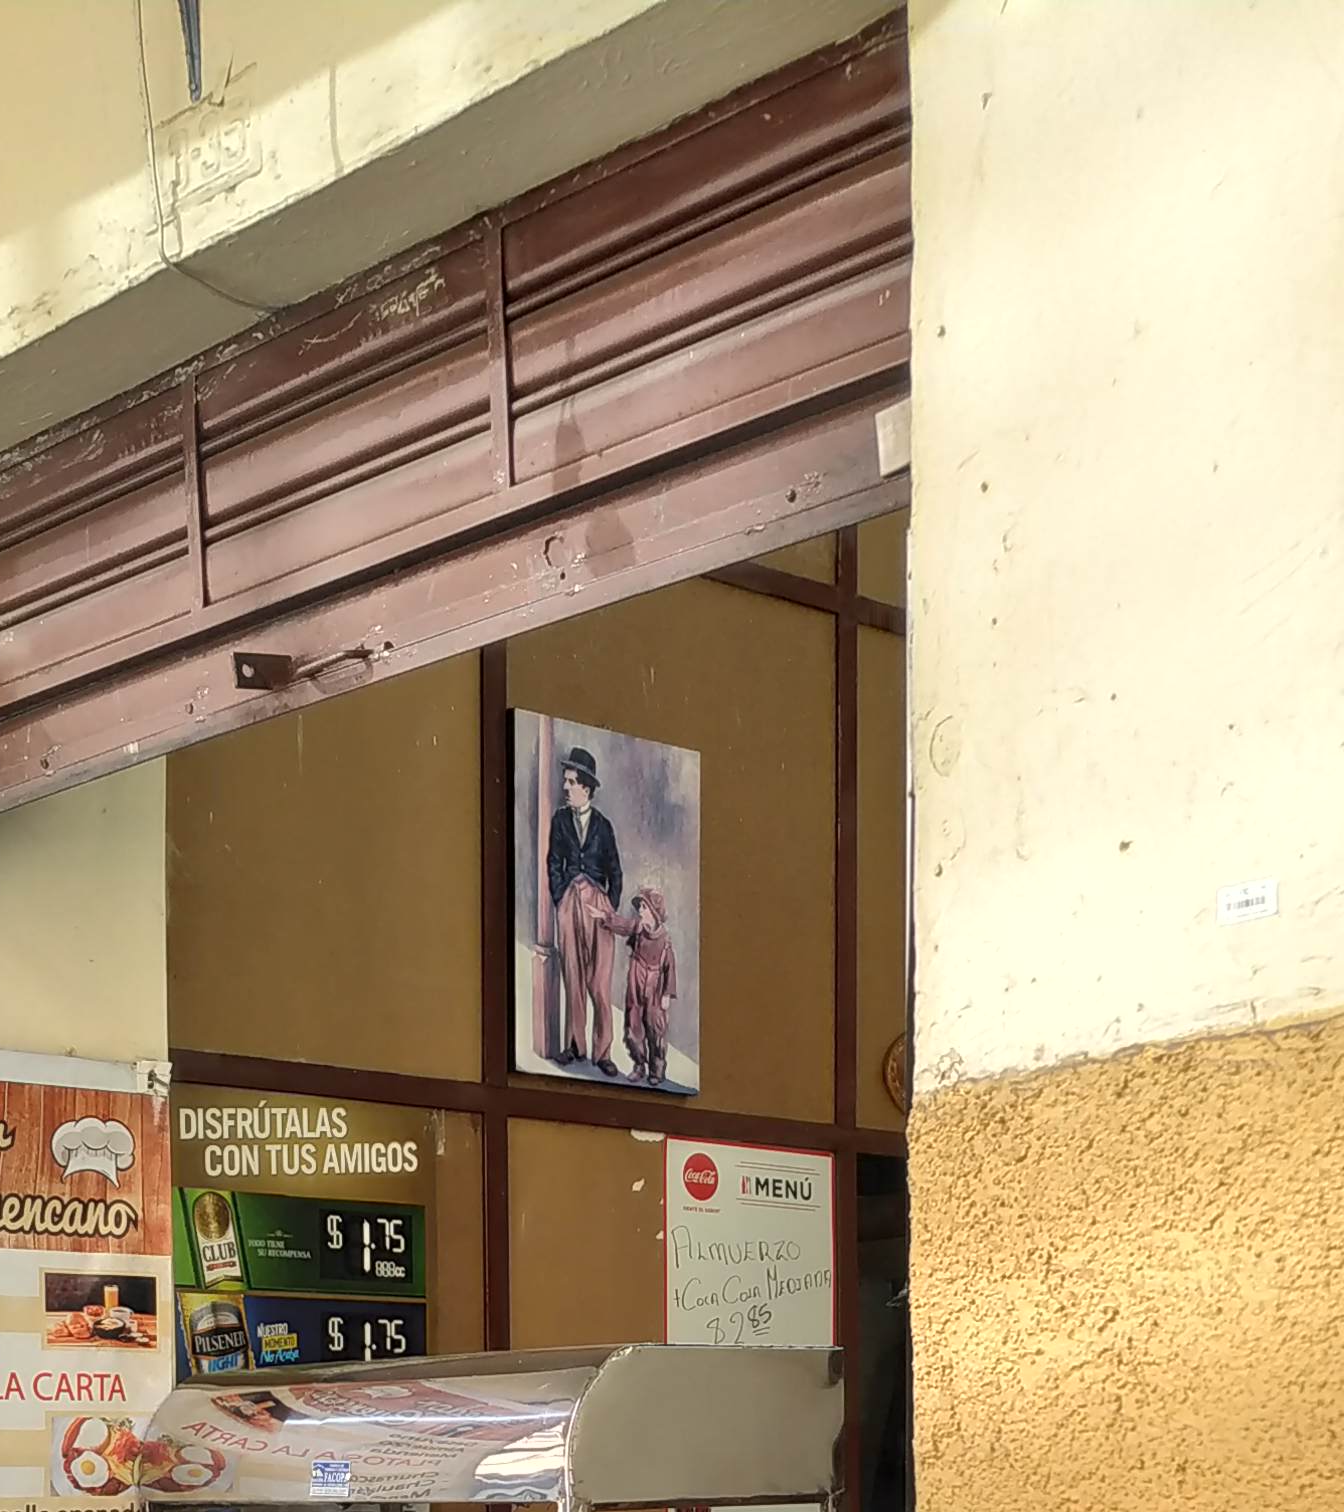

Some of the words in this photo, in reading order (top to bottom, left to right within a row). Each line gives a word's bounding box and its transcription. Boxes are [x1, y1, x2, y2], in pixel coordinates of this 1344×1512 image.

[179, 1100, 348, 1140] DISFRÚTALAS
[205, 1144, 259, 1176] CON
[265, 1143, 317, 1175] TUS
[323, 1141, 419, 1174] AMIGOS
[755, 1177, 812, 1201] MENÚ
[202, 1241, 236, 1262] CLUB
[327, 1214, 343, 1249] $
[363, 1218, 405, 1273] 1.75
[194, 1330, 246, 1353] PILSENER
[257, 1323, 288, 1337] NUESTRO
[264, 1336, 296, 1348] MOMENTO
[328, 1317, 344, 1351] $
[33, 1372, 127, 1402] CARTA
